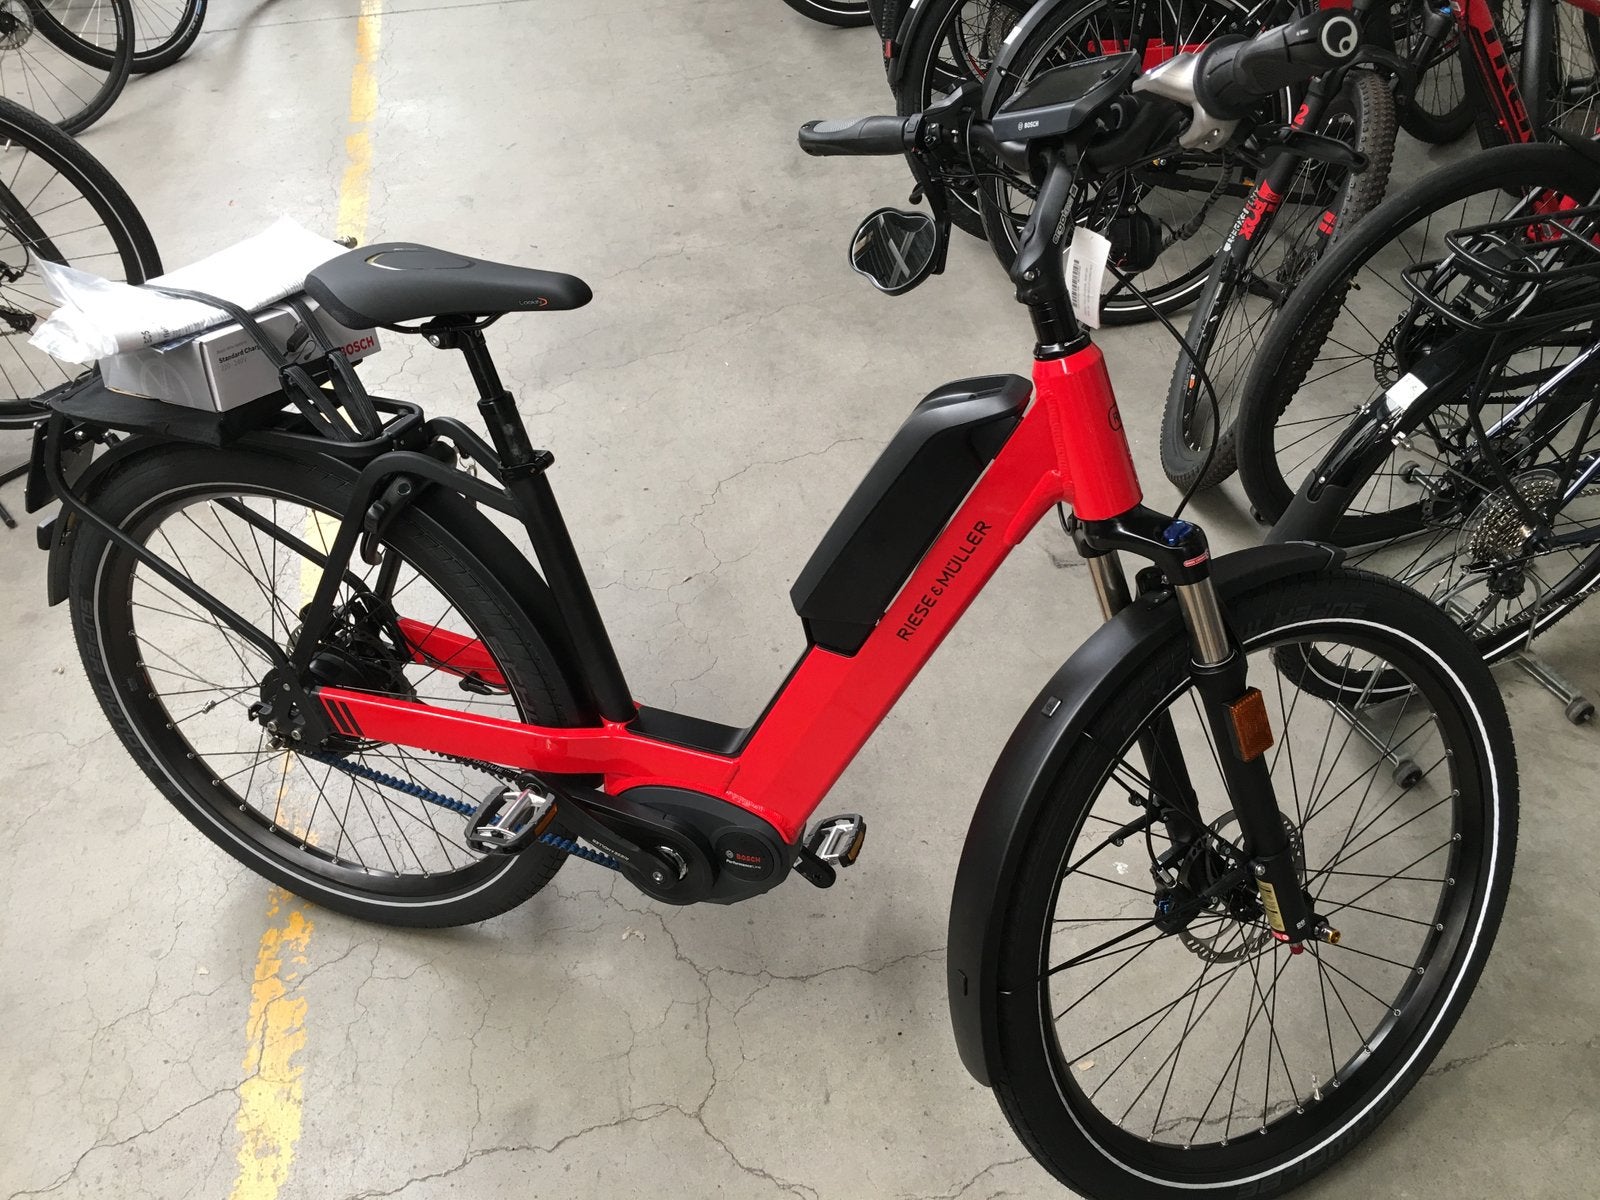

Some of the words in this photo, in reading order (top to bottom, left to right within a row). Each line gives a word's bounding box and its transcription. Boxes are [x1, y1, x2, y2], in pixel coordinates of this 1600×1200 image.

[1024, 121, 1039, 129] BOSCH
[218, 347, 244, 364] Standard
[896, 594, 938, 641] RIESE
[936, 520, 992, 588] MÜLLER
[736, 853, 761, 863] BOSCH
